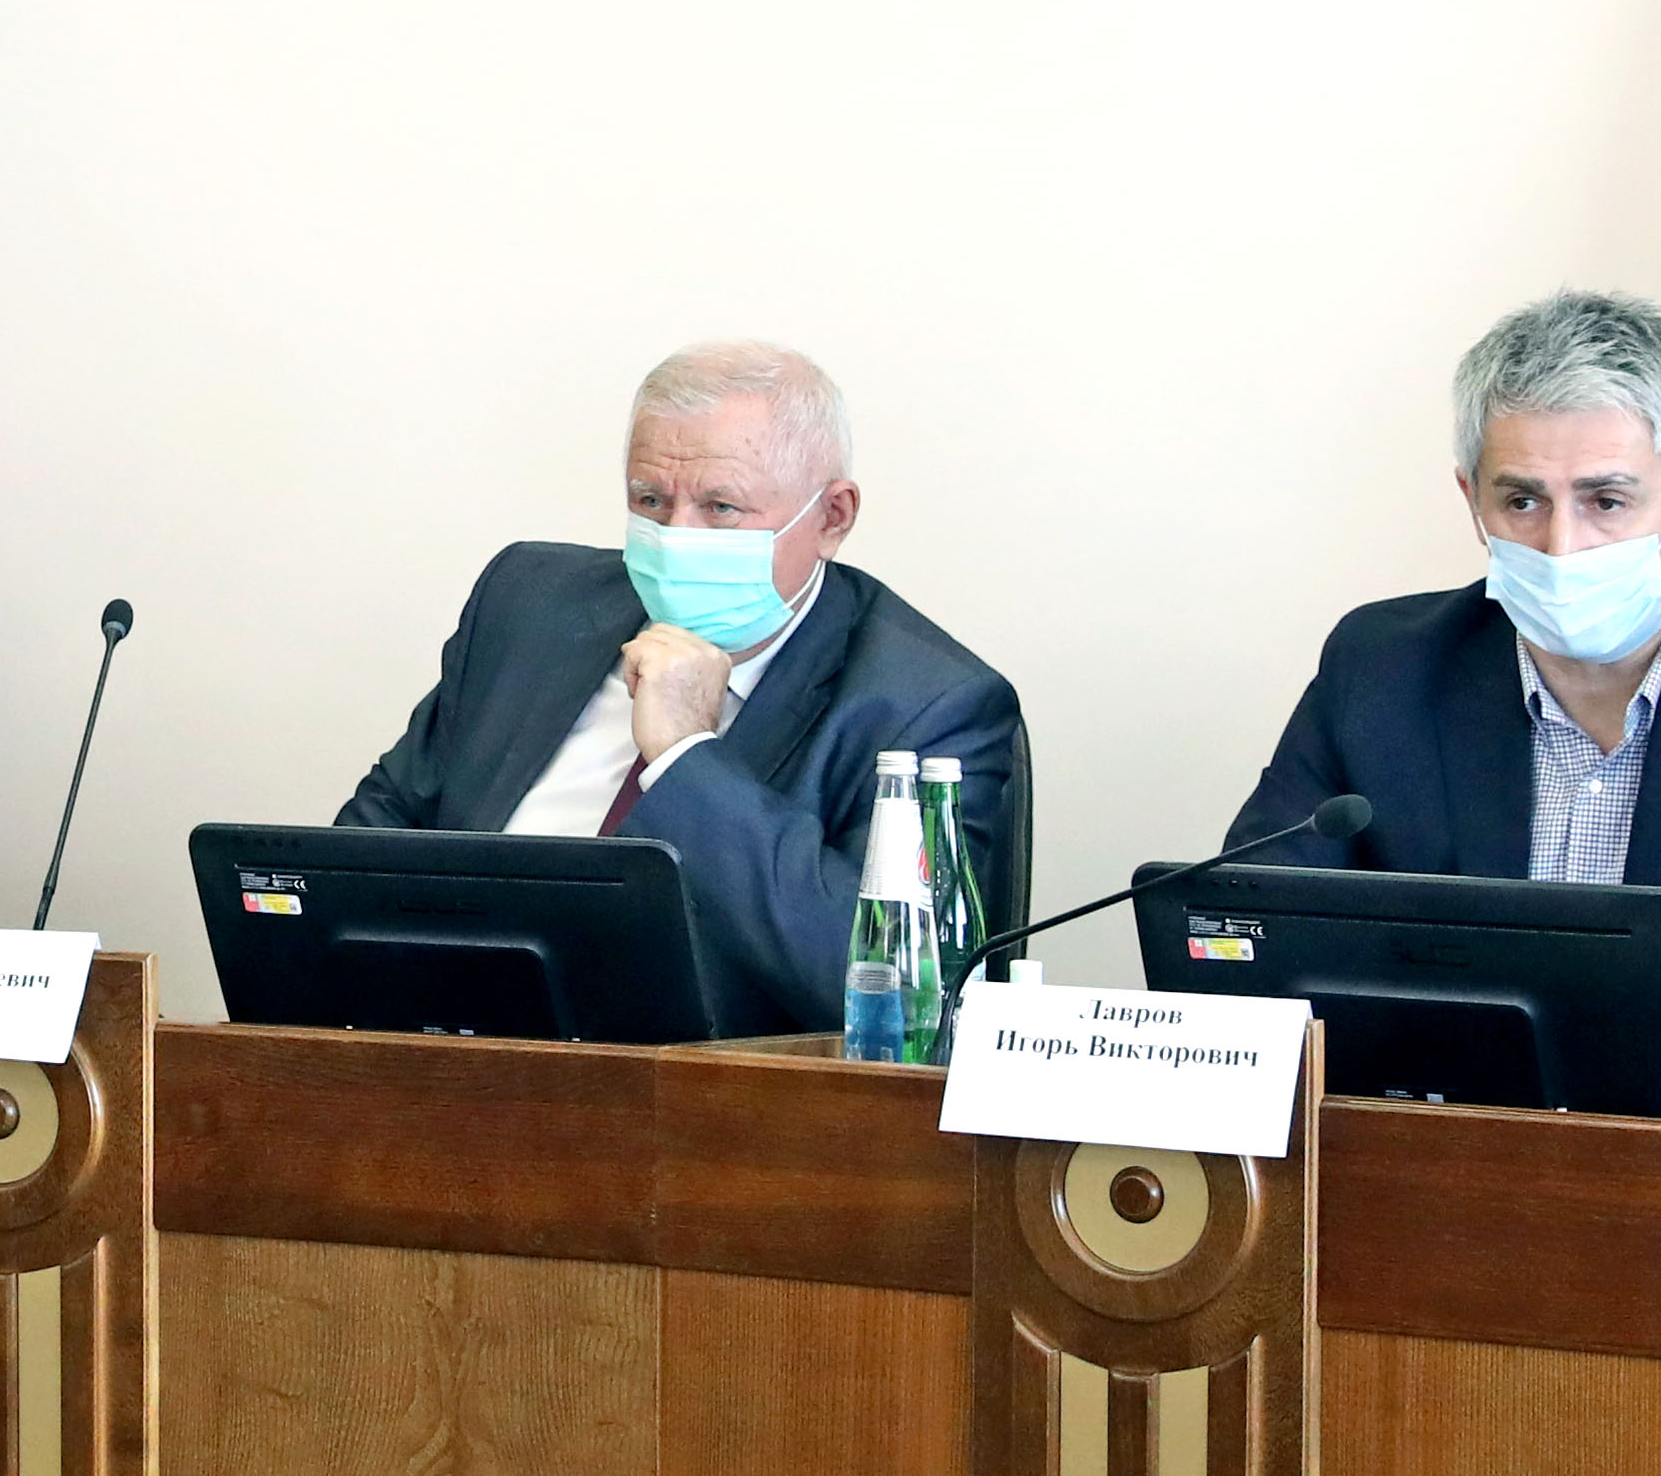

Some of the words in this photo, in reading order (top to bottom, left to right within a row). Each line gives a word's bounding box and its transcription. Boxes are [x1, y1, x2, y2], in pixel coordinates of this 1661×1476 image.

[1078, 999, 1183, 1029] Лавров
[995, 1029, 1079, 1061] Игорь
[1088, 1034, 1258, 1069] Викторович
